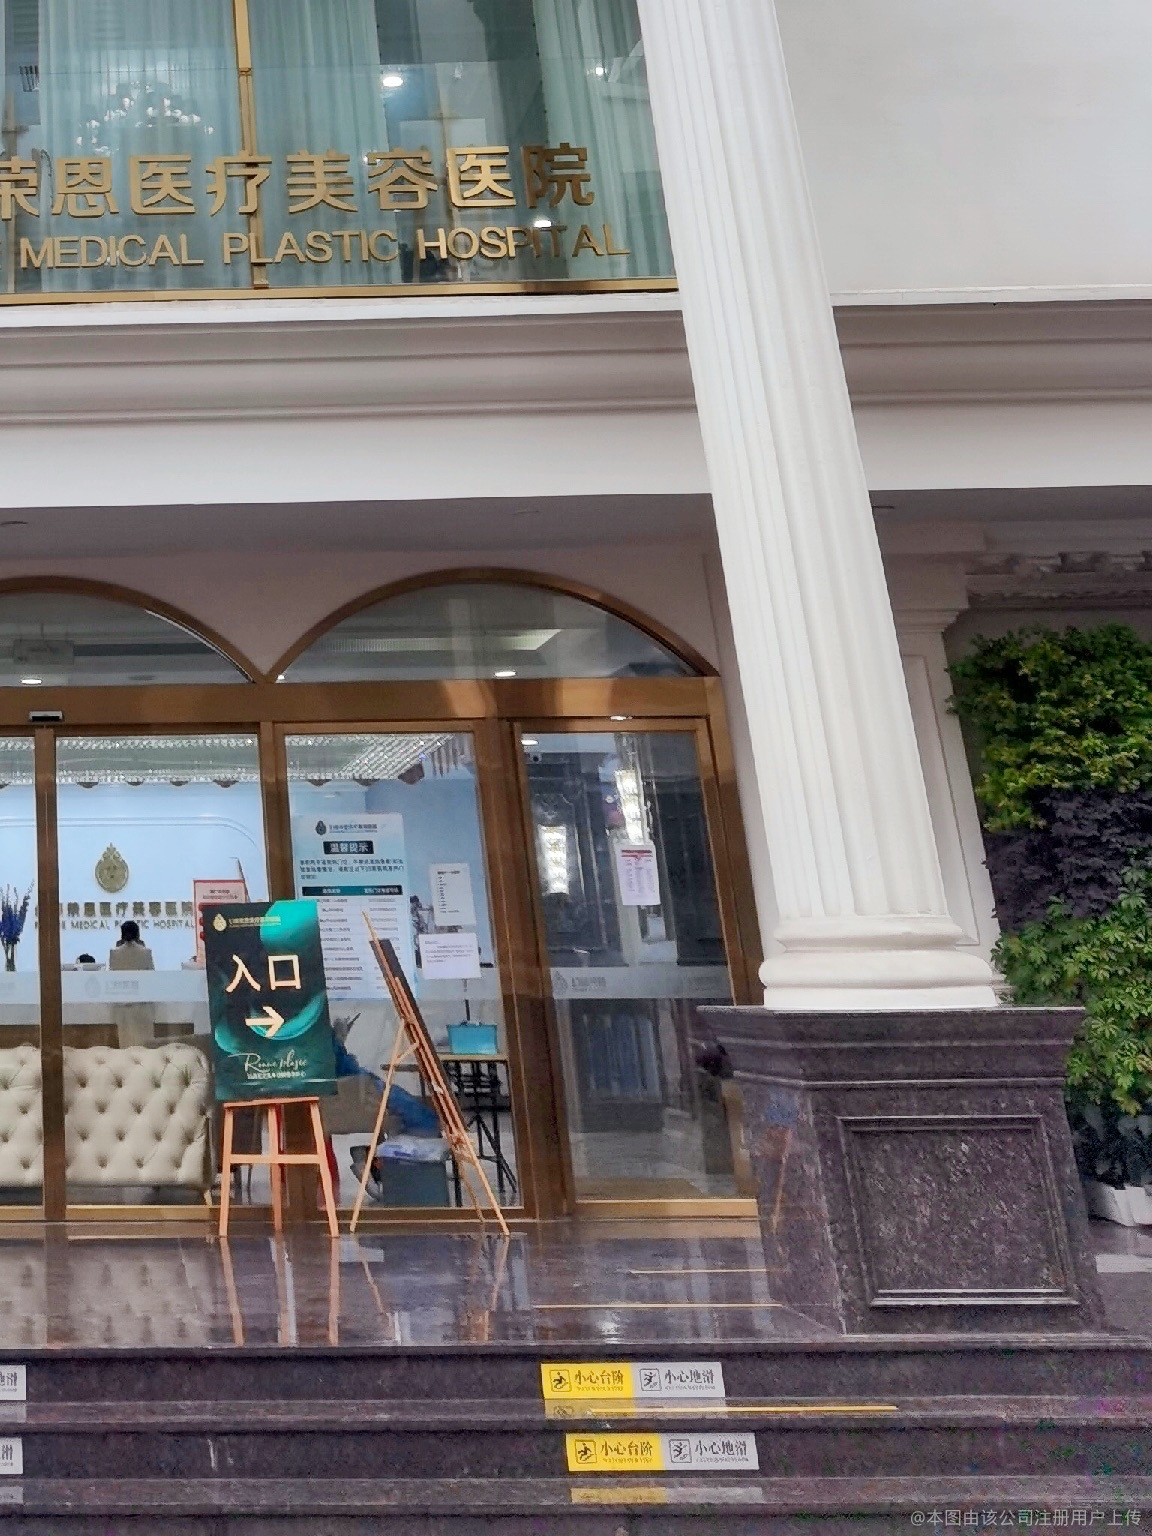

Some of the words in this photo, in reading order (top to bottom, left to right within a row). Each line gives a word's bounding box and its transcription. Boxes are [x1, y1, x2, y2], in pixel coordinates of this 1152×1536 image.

[20, 232, 204, 269] MEDICAL
[222, 229, 398, 265] PLASTIC
[417, 223, 630, 260] HOSPITAL
[70, 919, 111, 931] MEDICAL
[153, 919, 195, 930] HOSPITAL
[225, 954, 301, 992] 入口
[574, 1369, 624, 1385] 小心台阶
[665, 1368, 715, 1385] 小心地滑
[600, 1439, 654, 1456] 小心台阶
[695, 1439, 748, 1456] 小心地滑
